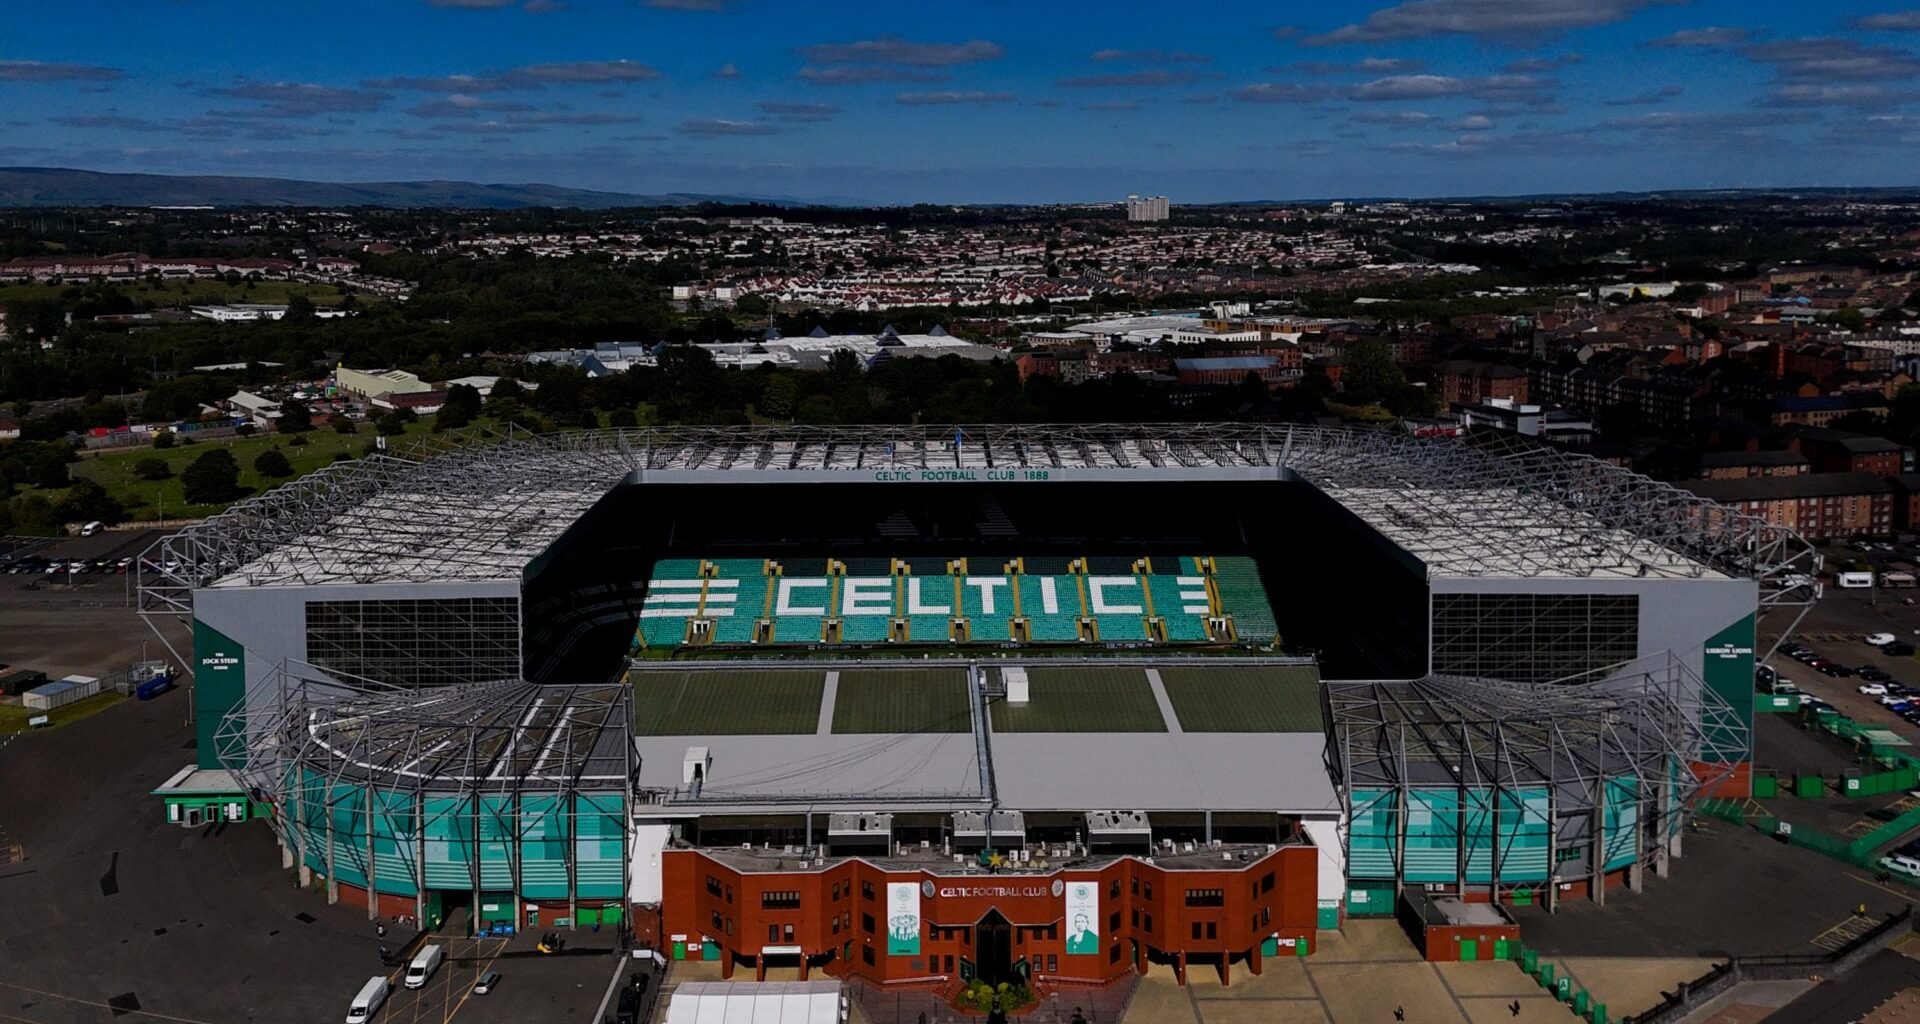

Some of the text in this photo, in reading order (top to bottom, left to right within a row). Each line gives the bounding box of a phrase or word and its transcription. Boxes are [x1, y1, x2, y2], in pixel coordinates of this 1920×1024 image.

[875, 471, 1049, 481] CELTIC FOOTBALL CLUB 1888
[775, 577, 1143, 616] CELTIC
[940, 887, 1047, 898] CELTIC FOOTBALL CLUB
